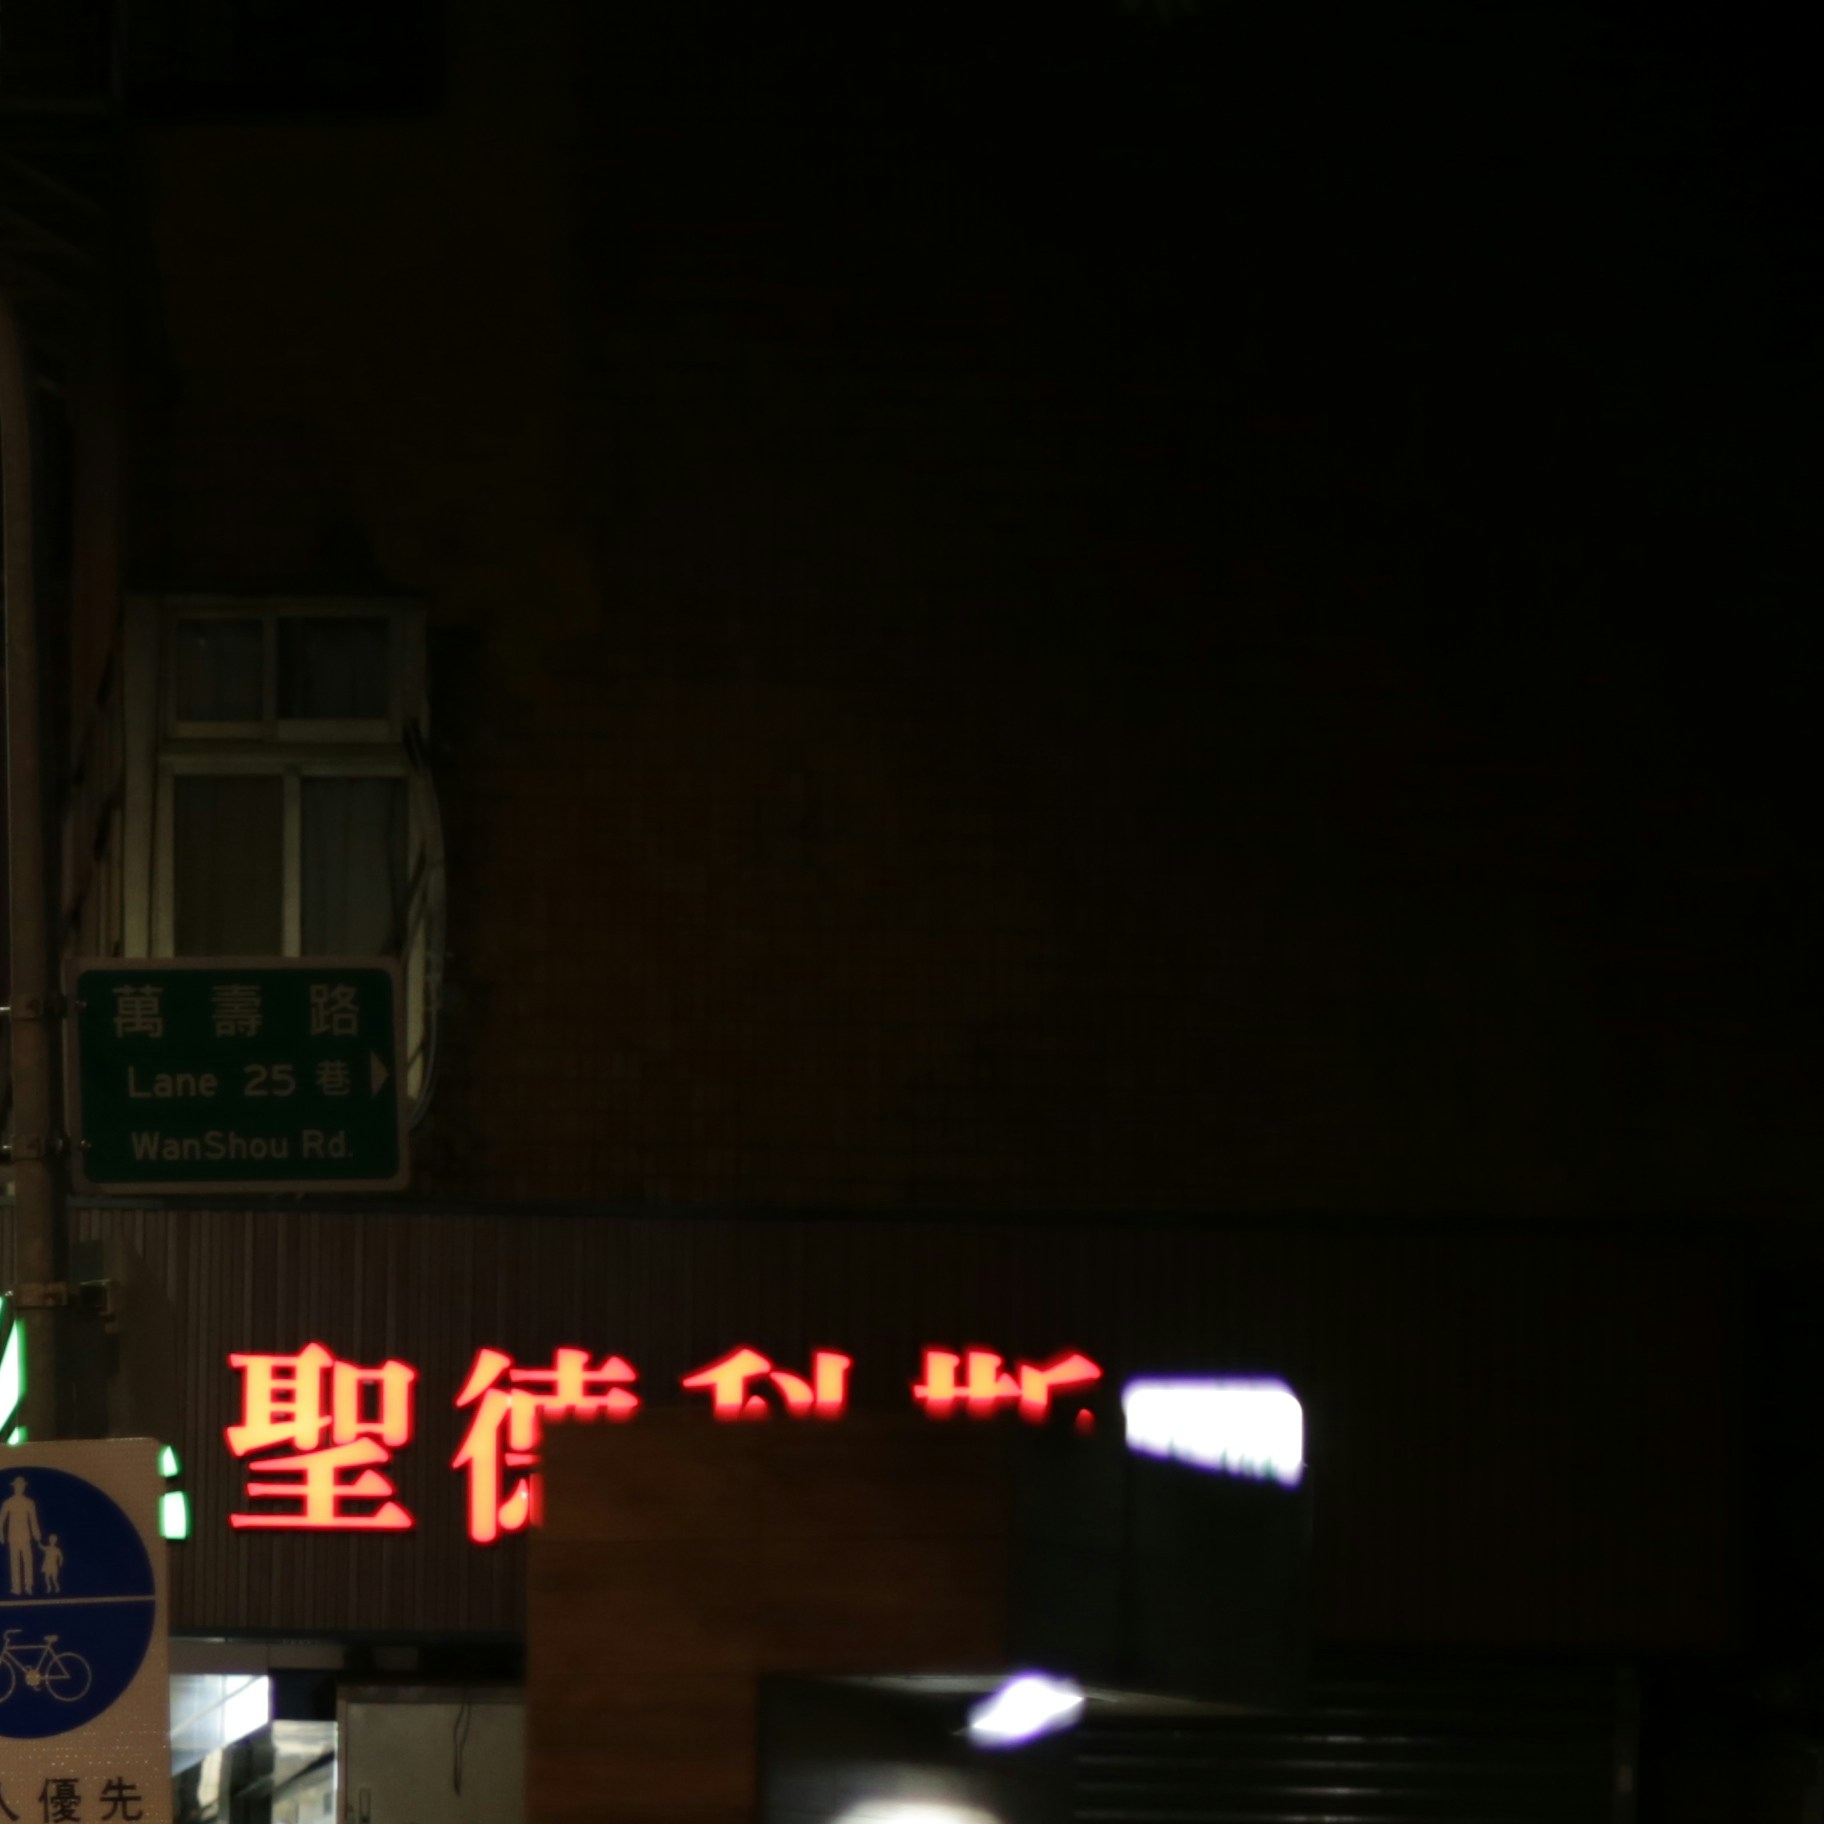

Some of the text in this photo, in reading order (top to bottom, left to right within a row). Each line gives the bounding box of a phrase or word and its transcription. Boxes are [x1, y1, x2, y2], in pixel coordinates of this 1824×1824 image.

[112, 984, 360, 1039] 萬壽路
[127, 1060, 352, 1099] Lane 25 巷
[131, 1129, 354, 1162] WanShou Rd.
